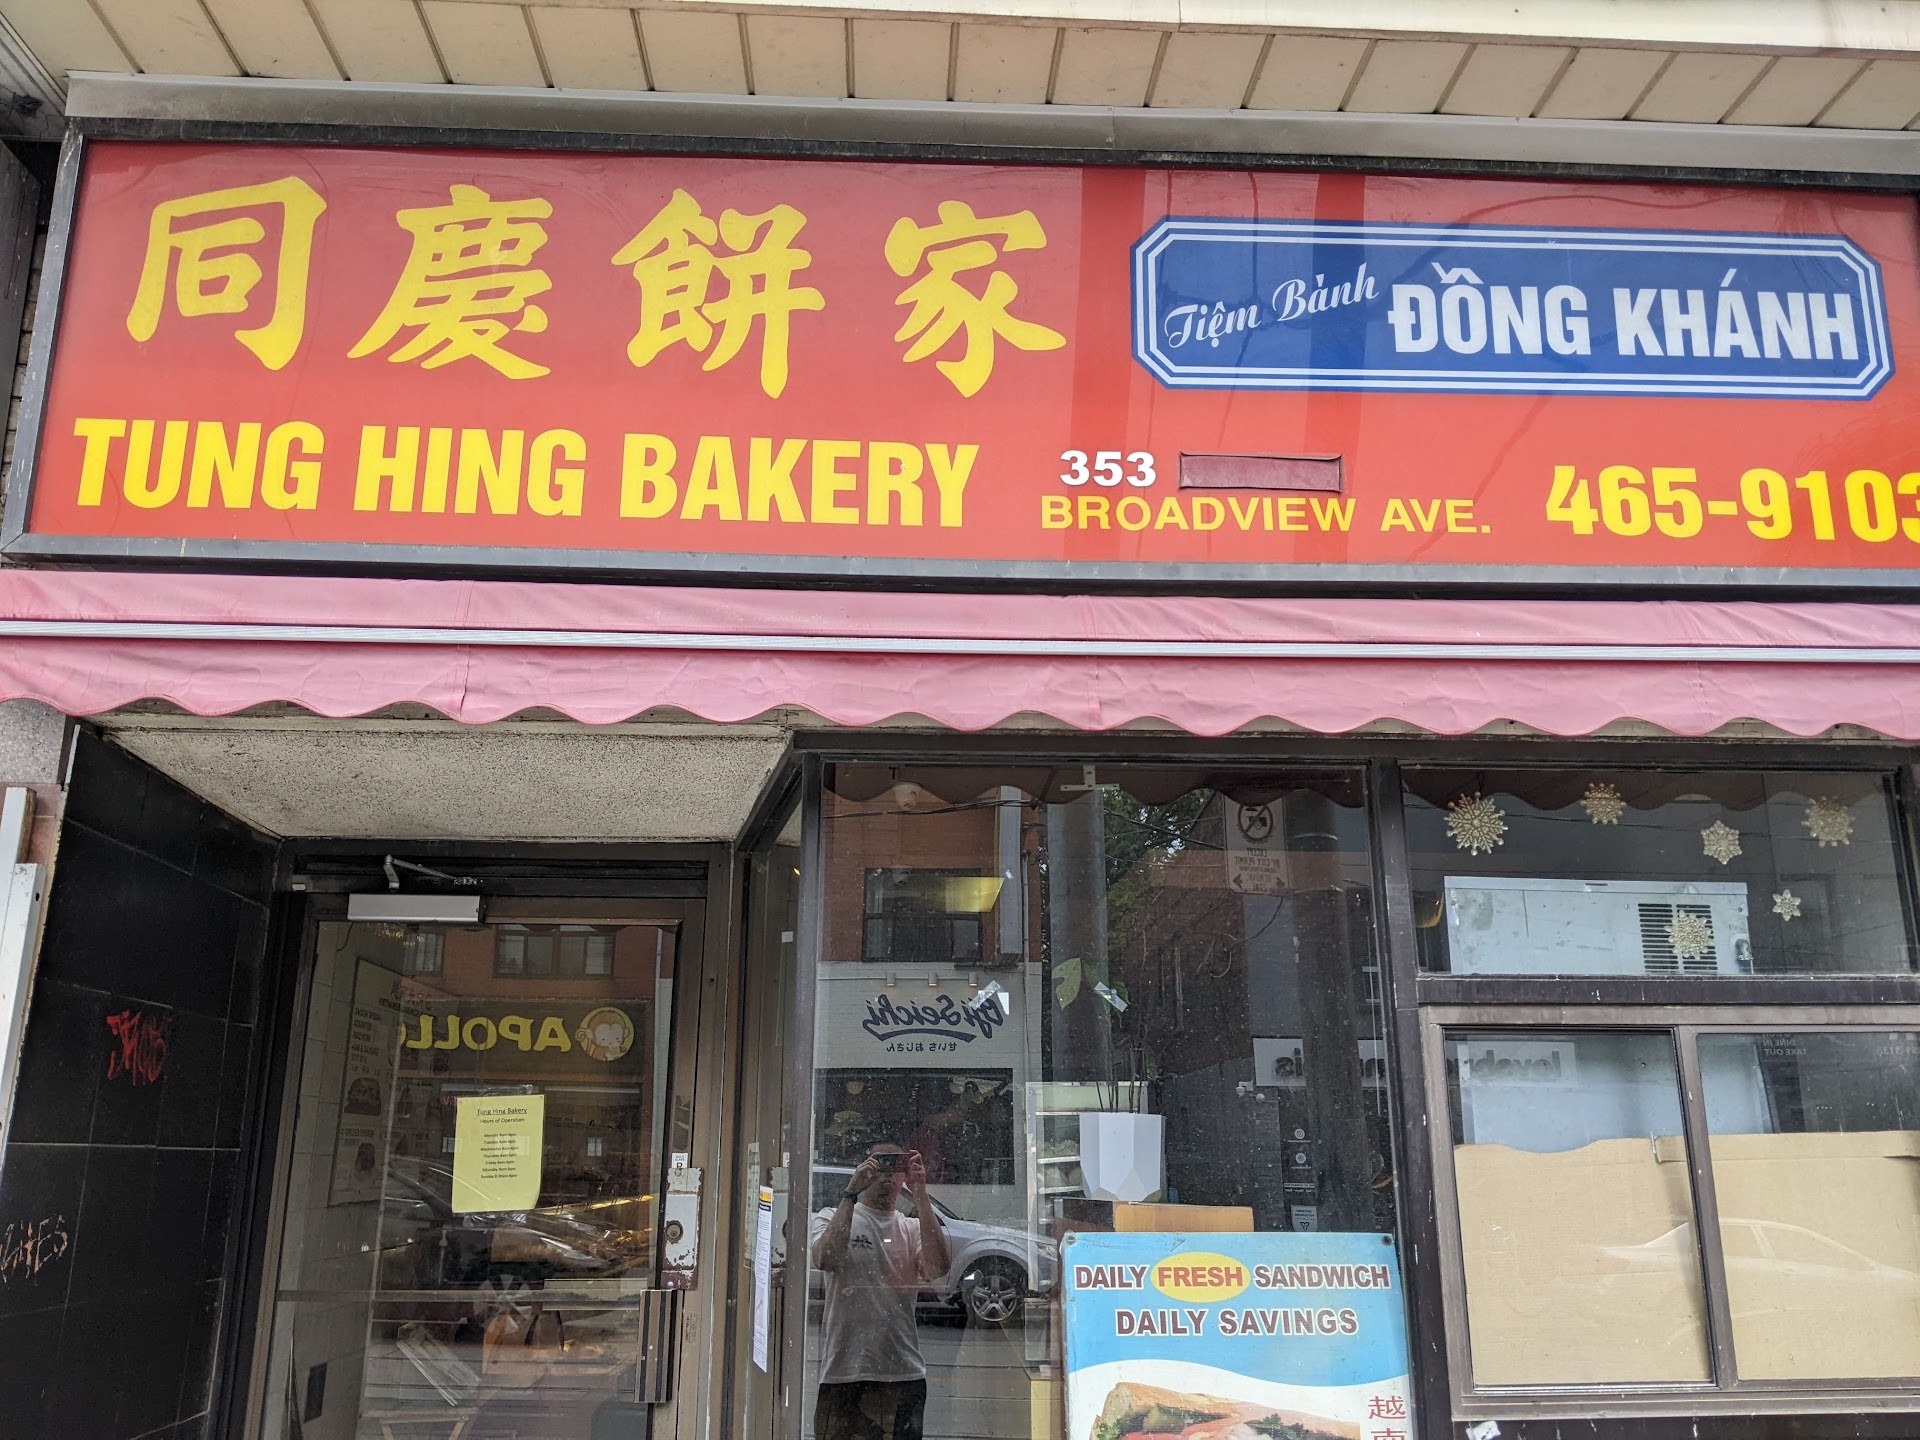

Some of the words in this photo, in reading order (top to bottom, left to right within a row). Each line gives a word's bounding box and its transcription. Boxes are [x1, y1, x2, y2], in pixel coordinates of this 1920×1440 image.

[128, 179, 1066, 398] 同慶餅家
[1388, 262, 1592, 355] ĐỒNG
[1613, 268, 1859, 360] KHÁNH
[74, 418, 325, 510] TUNG
[354, 426, 587, 516] HING
[620, 434, 979, 528] BAKERY
[1060, 450, 1156, 487] 353
[1041, 495, 1356, 532] BROADVIEW
[1382, 499, 1491, 534] AVE.
[507, 1107, 528, 1115] Bakery
[1074, 1265, 1149, 1290] DAILY
[1157, 1266, 1243, 1287] FRESH
[1254, 1264, 1391, 1289] SANDWICH
[1116, 1309, 1207, 1336] DAILY
[1219, 1308, 1360, 1336] SAVINGS
